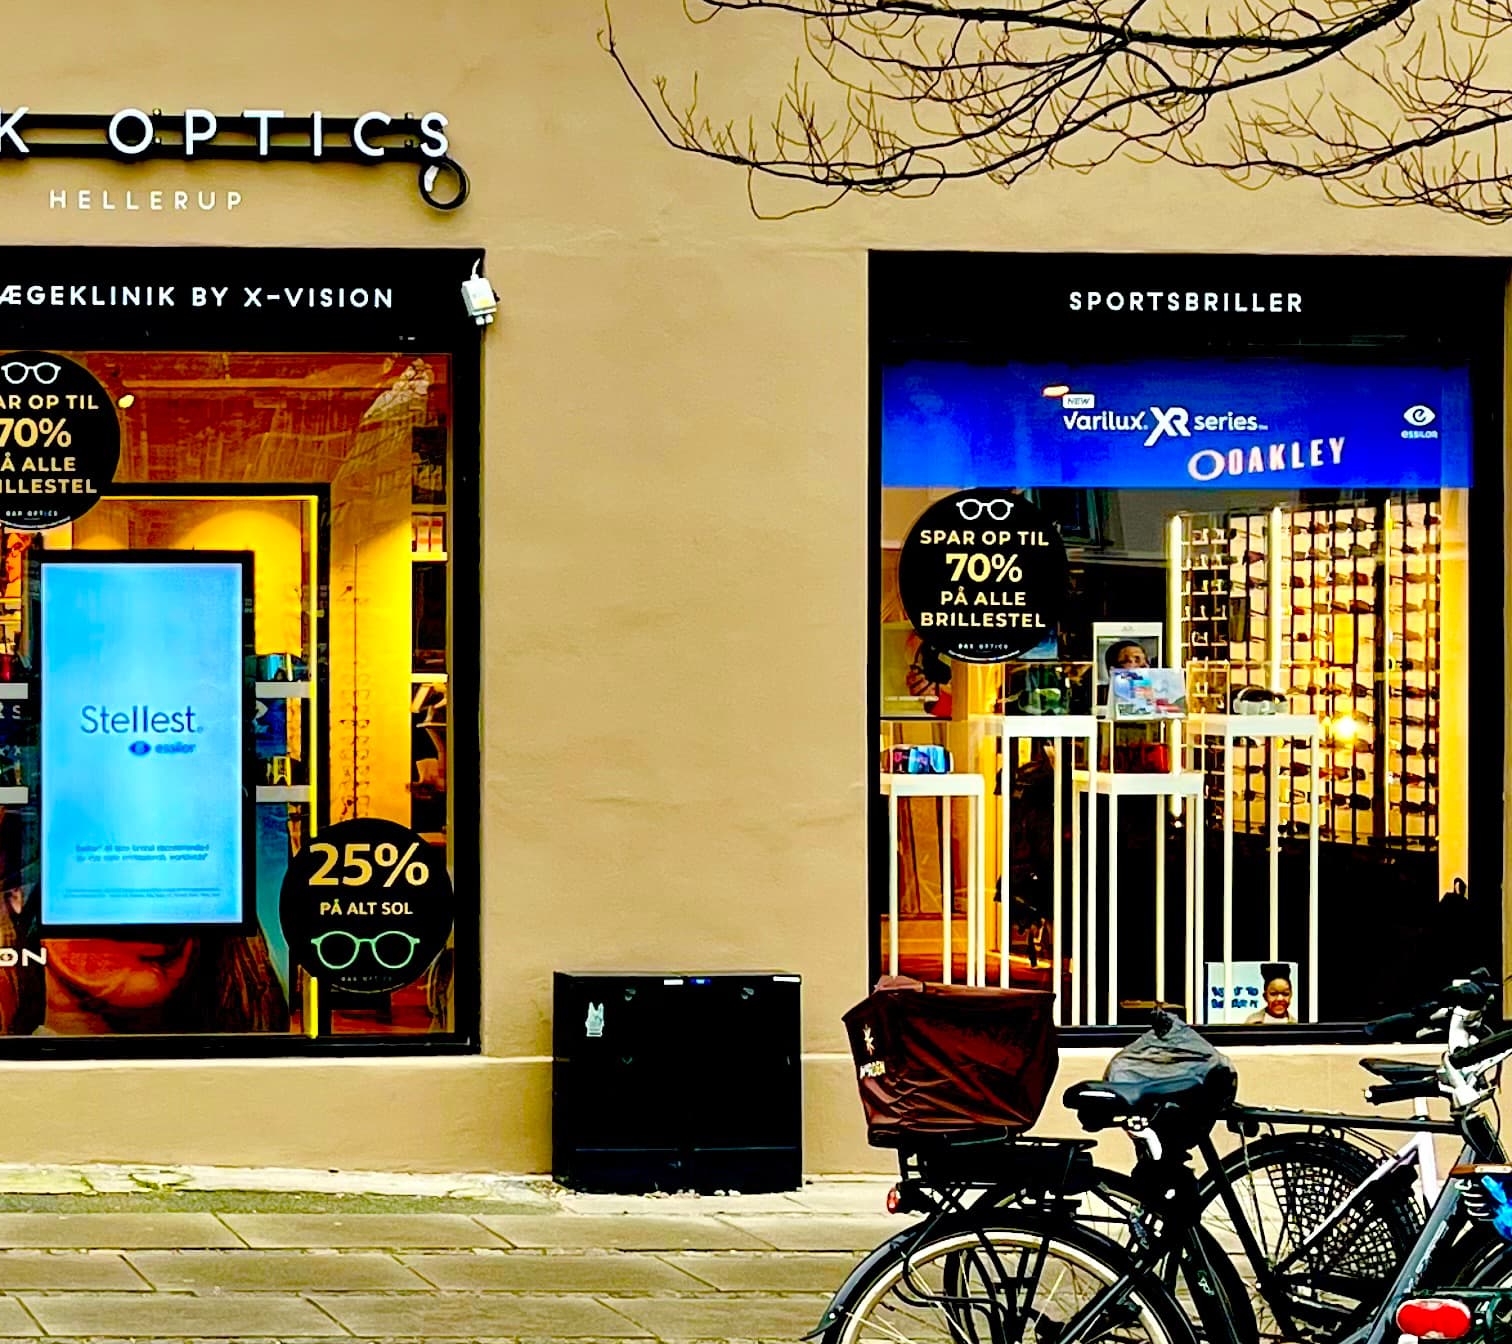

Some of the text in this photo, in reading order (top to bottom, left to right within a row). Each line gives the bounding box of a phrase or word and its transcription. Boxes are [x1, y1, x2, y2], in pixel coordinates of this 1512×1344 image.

[108, 107, 449, 157] OPTICS
[49, 189, 244, 211] HELLERUP
[192, 286, 229, 308] BY
[244, 287, 393, 308] X-VISION
[1069, 292, 1303, 313] SPORTSBRILLER
[28, 394, 59, 410] OP
[65, 394, 99, 410] TIL
[1143, 406, 1191, 447] XR
[22, 457, 76, 472] ALLE
[1227, 437, 1346, 474] OAKLEY
[920, 530, 1049, 546] SPAR OP TIL
[945, 553, 1023, 583] 70%
[941, 585, 1026, 606] PÅ ALLE
[920, 612, 1046, 627] BRILLESTEL
[309, 842, 430, 887] 25%
[320, 899, 413, 915] PÅ ALT SOL
